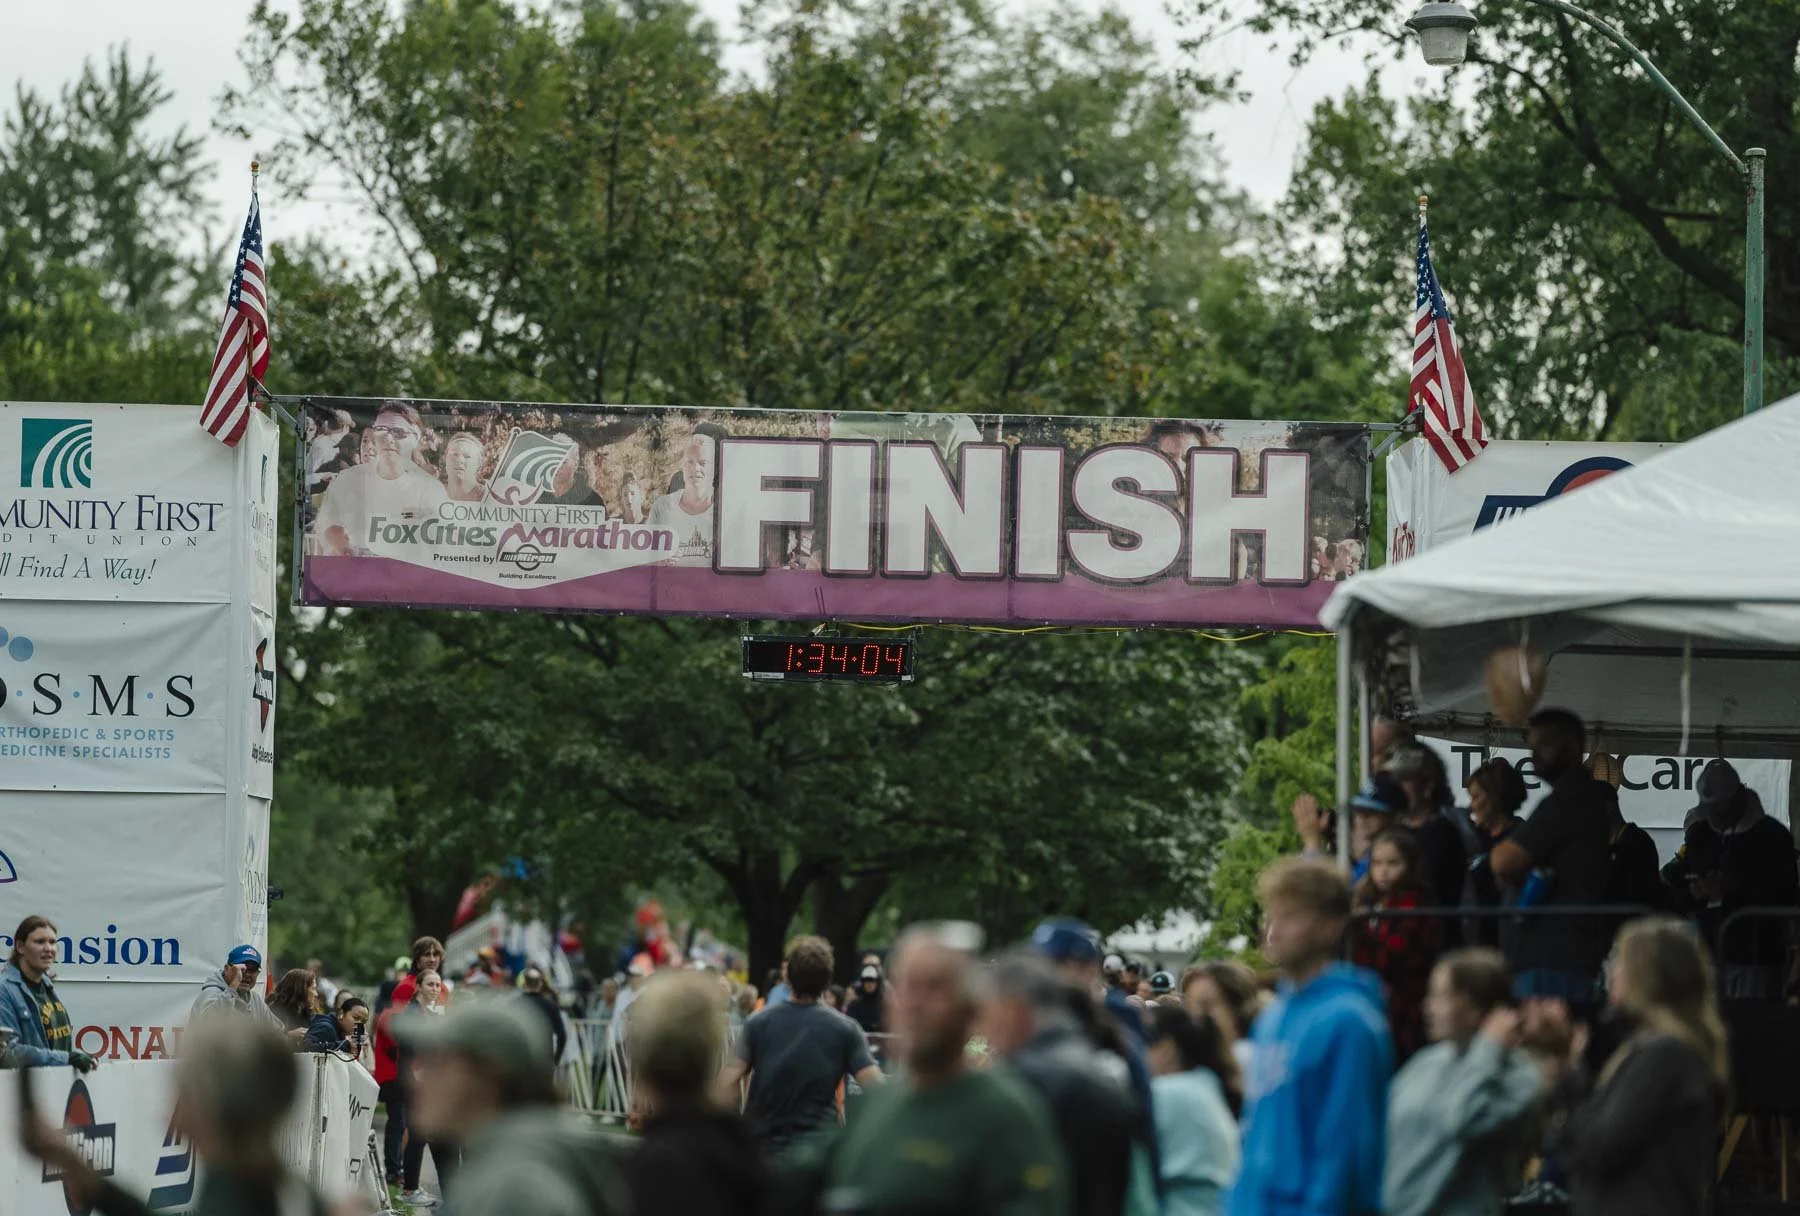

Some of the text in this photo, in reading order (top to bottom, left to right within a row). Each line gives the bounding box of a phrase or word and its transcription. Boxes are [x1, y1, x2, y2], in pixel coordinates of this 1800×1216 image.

[135, 494, 223, 532] FIRST
[439, 502, 602, 524] COMMUNITY FIRST
[714, 437, 1311, 585] FINISH
[86, 535, 197, 546] UNION
[496, 521, 673, 563] Marathon
[16, 553, 68, 578] Find
[72, 556, 92, 578] A
[103, 558, 157, 585] Way!
[433, 554, 495, 565] Presented by
[95, 728, 107, 741] &
[113, 728, 175, 741] SPORTS
[72, 745, 171, 759] SPECIALISTS
